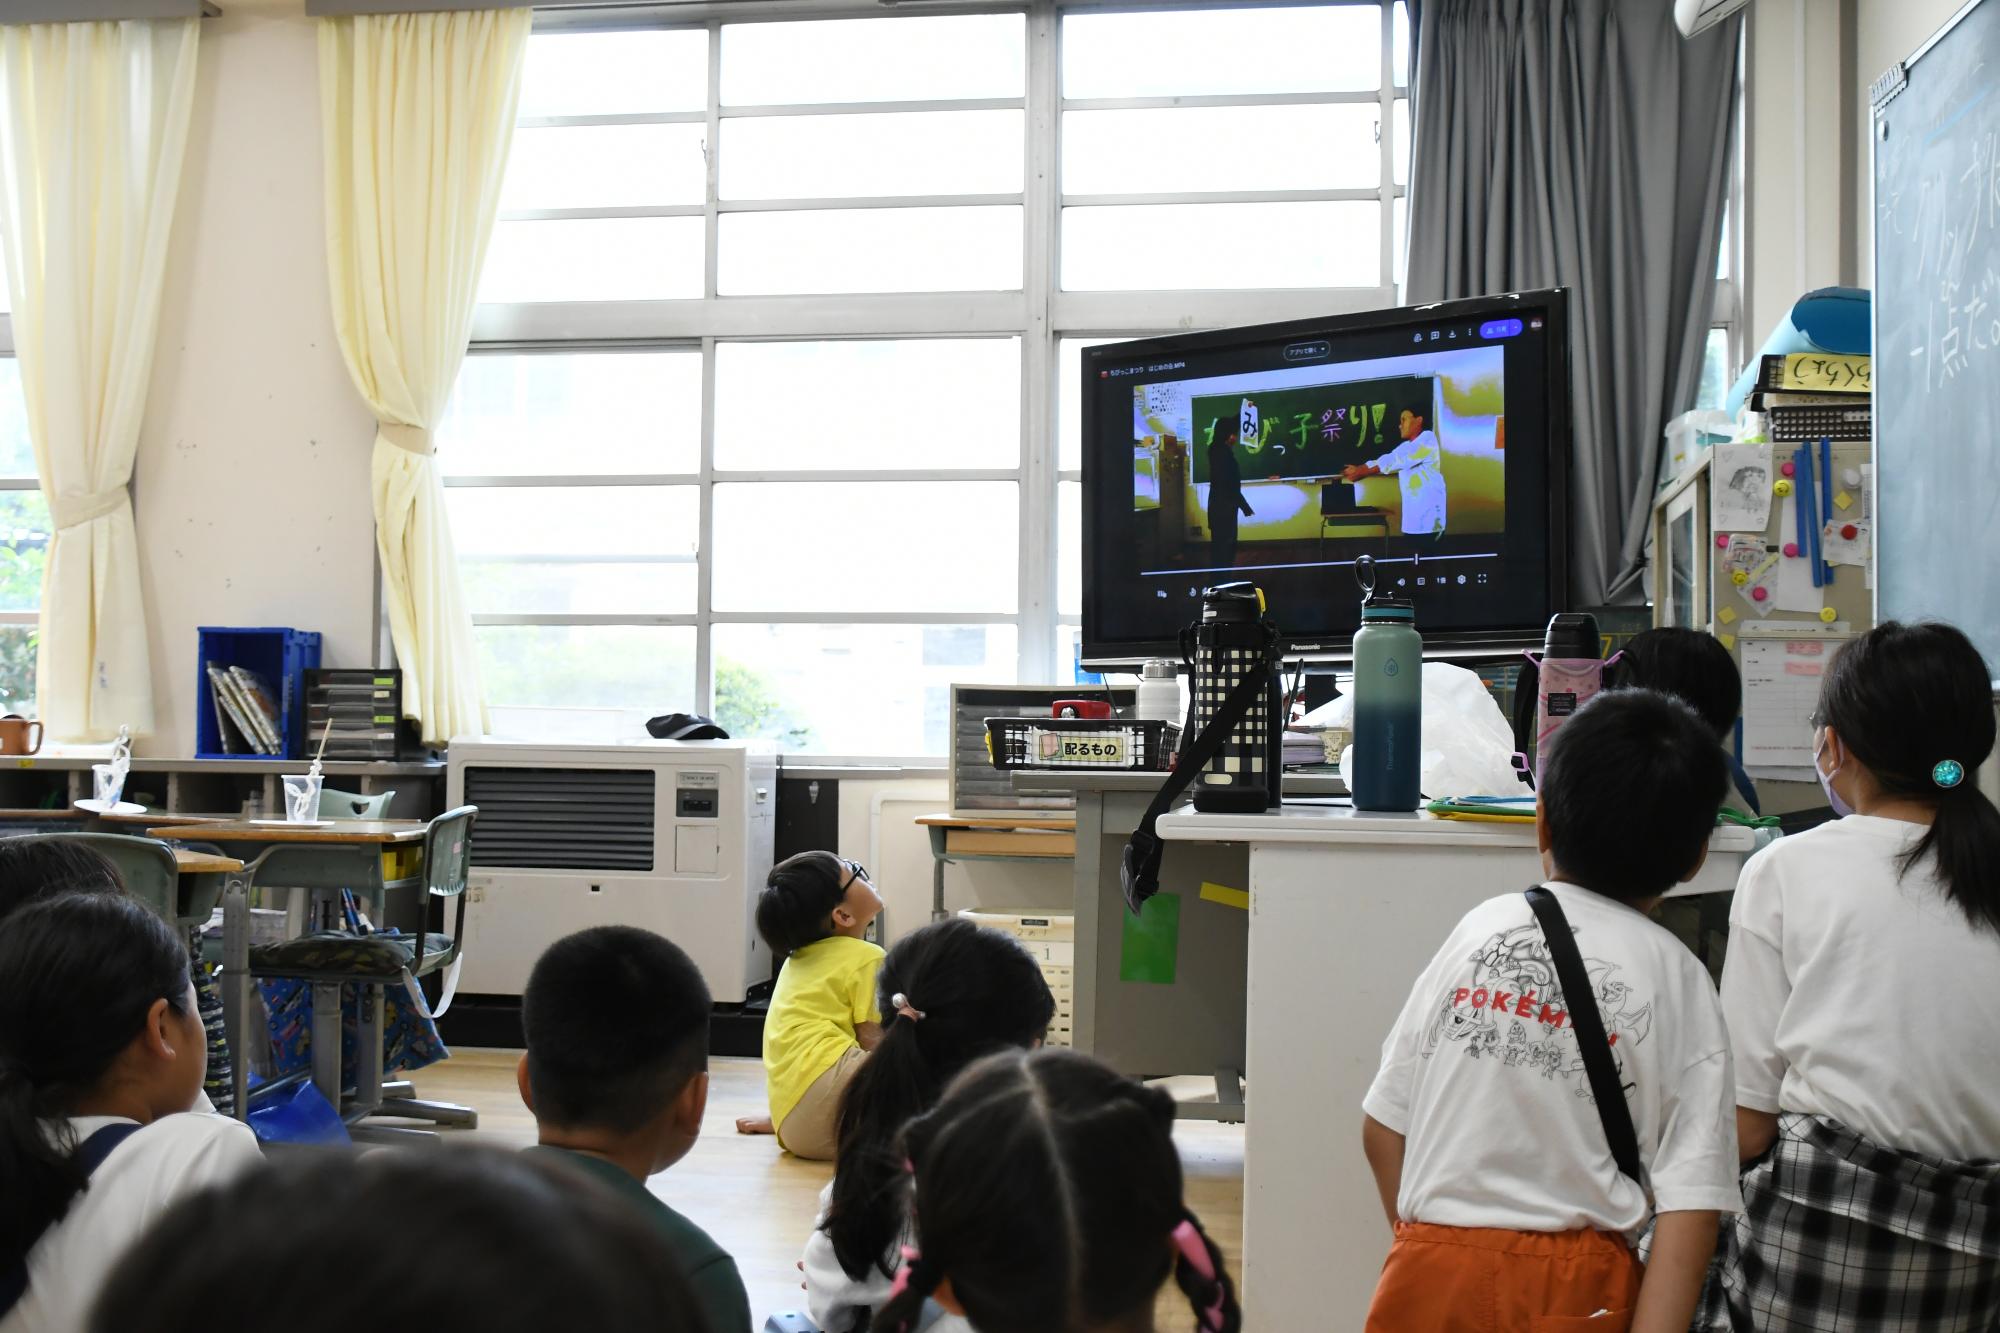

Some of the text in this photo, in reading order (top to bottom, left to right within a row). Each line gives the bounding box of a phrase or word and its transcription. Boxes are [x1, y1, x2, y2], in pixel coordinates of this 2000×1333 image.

[1064, 742, 1117, 756] 配るもの
[1454, 988, 1618, 1047] POKÉM
